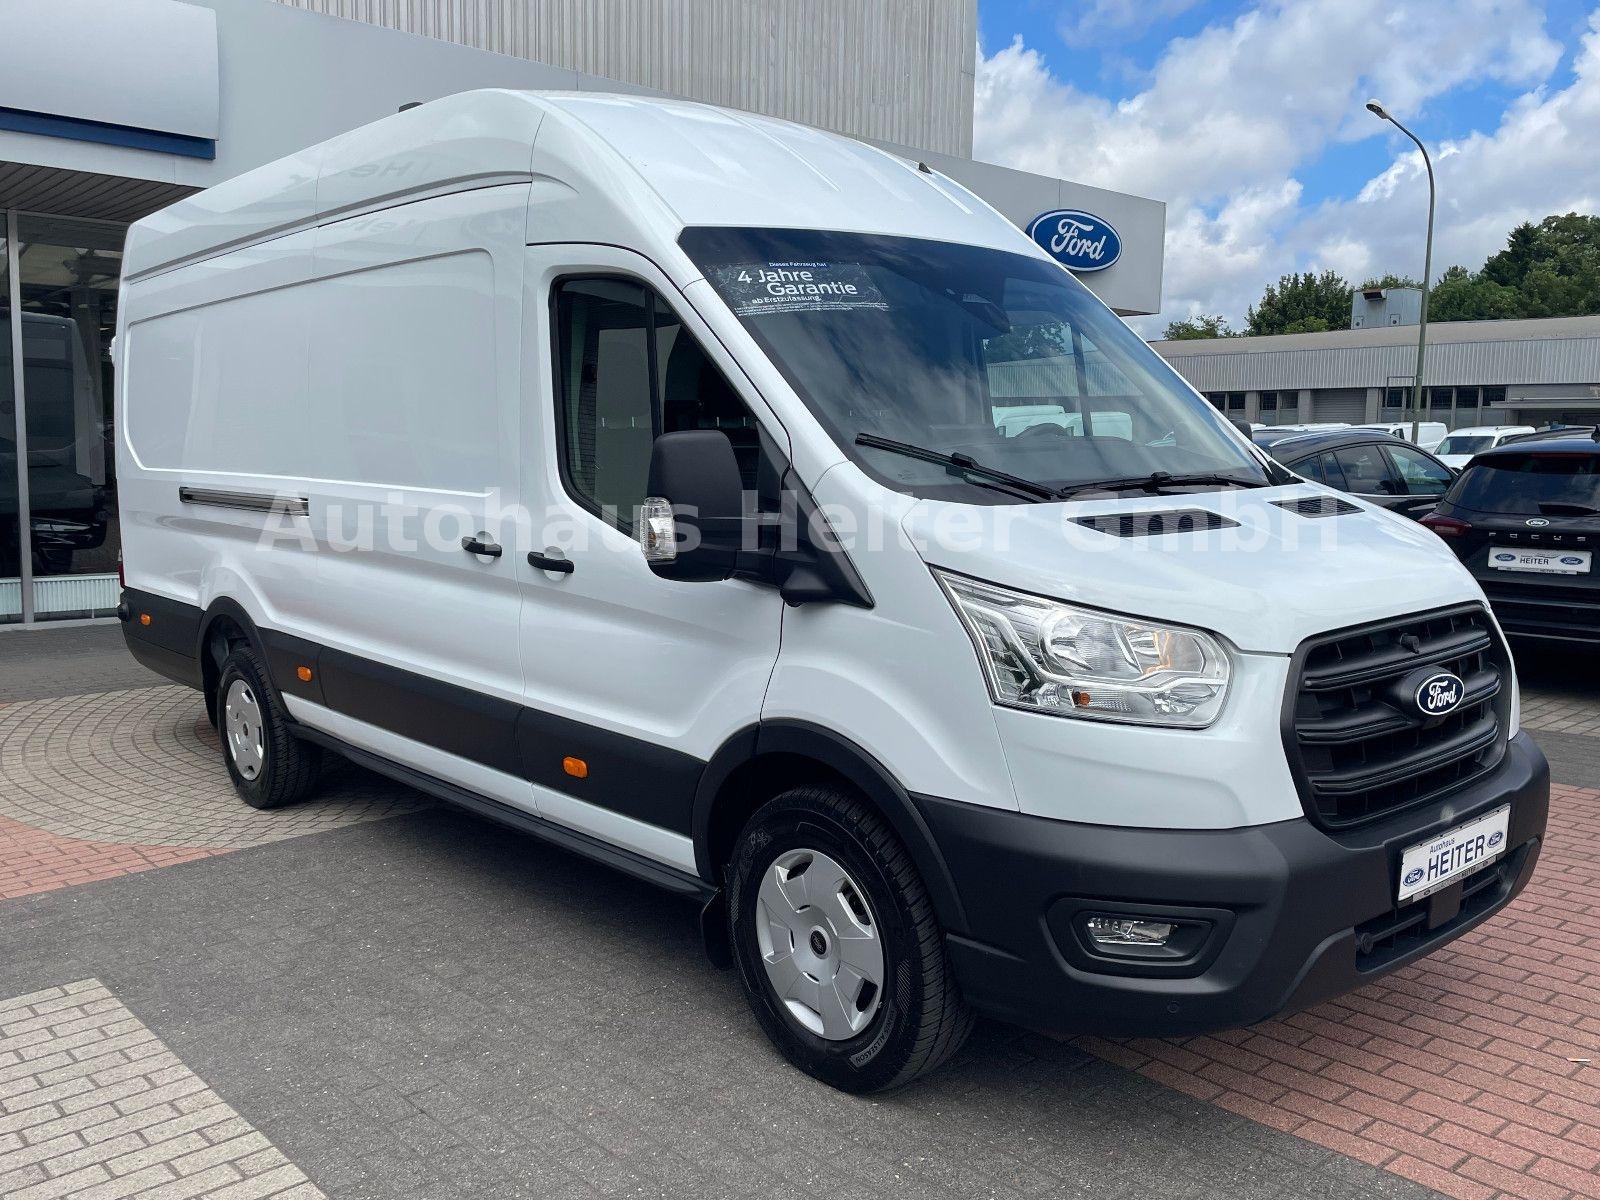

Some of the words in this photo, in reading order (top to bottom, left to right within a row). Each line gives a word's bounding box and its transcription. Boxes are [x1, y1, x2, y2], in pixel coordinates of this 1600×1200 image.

[1050, 218, 1106, 260] Ford
[738, 270, 752, 283] 4
[758, 268, 813, 282] Jahre
[766, 281, 858, 295] Garantie
[1520, 557, 1549, 565] HEITER
[1428, 680, 1456, 709] Ford
[1427, 834, 1485, 881] HEITER
